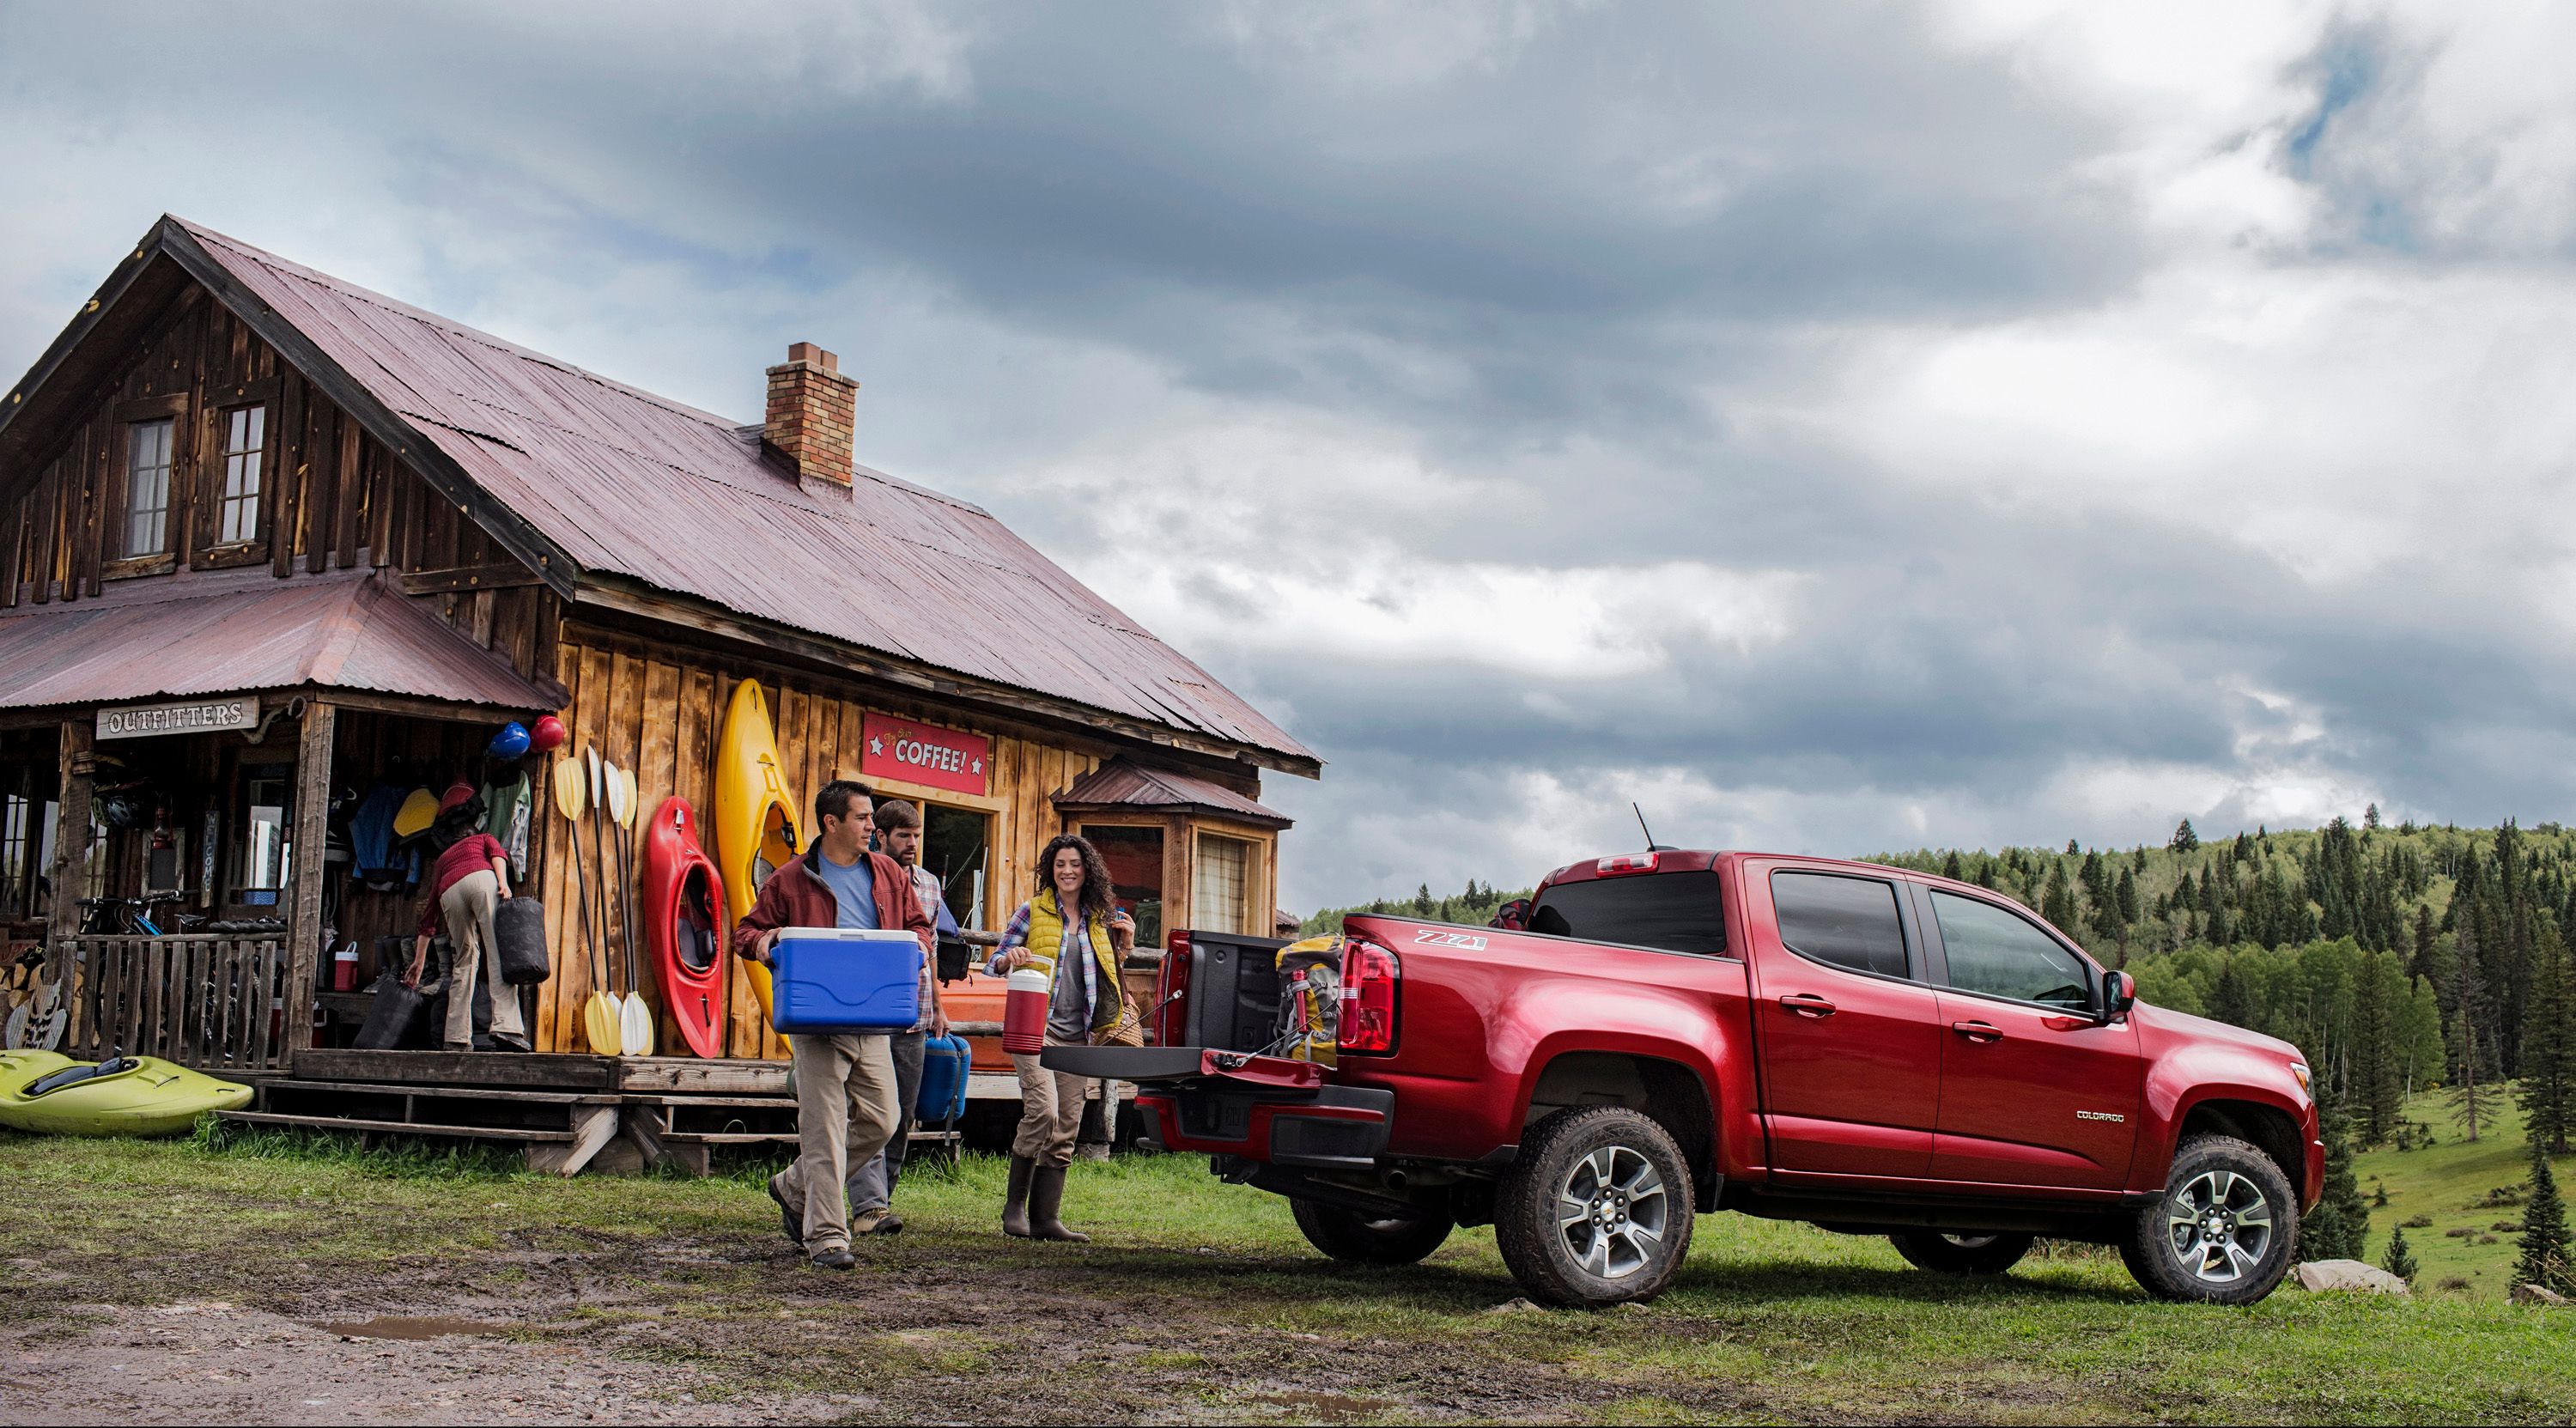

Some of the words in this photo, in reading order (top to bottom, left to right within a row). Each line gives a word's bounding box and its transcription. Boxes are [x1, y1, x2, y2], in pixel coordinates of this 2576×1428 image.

[108, 702, 242, 733] OUTFITTERS
[895, 738, 967, 775] COFFEE!
[205, 813, 216, 892] WELCOME
[1414, 930, 1488, 950] Z71
[2077, 1110, 2124, 1122] COLORADO
